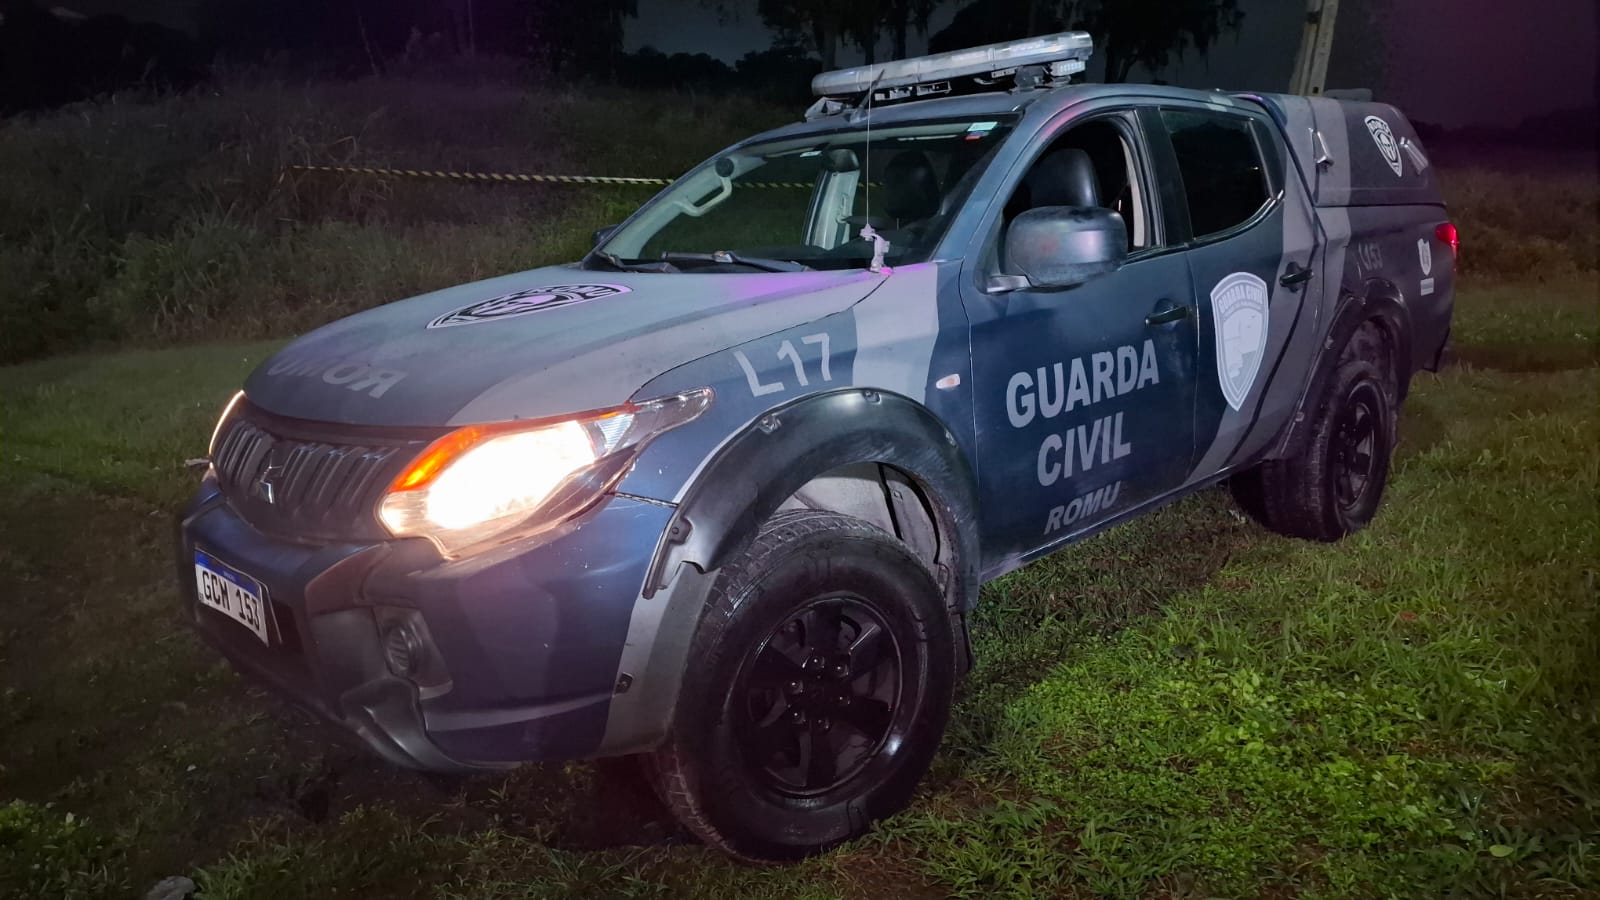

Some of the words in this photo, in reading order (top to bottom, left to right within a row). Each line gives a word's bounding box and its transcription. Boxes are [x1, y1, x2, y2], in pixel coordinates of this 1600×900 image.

[733, 332, 832, 397] L17
[1006, 338, 1160, 428] GUARDA
[1037, 411, 1131, 487] CIVIL
[1043, 480, 1121, 535] ROMU
[202, 570, 231, 611] GCM
